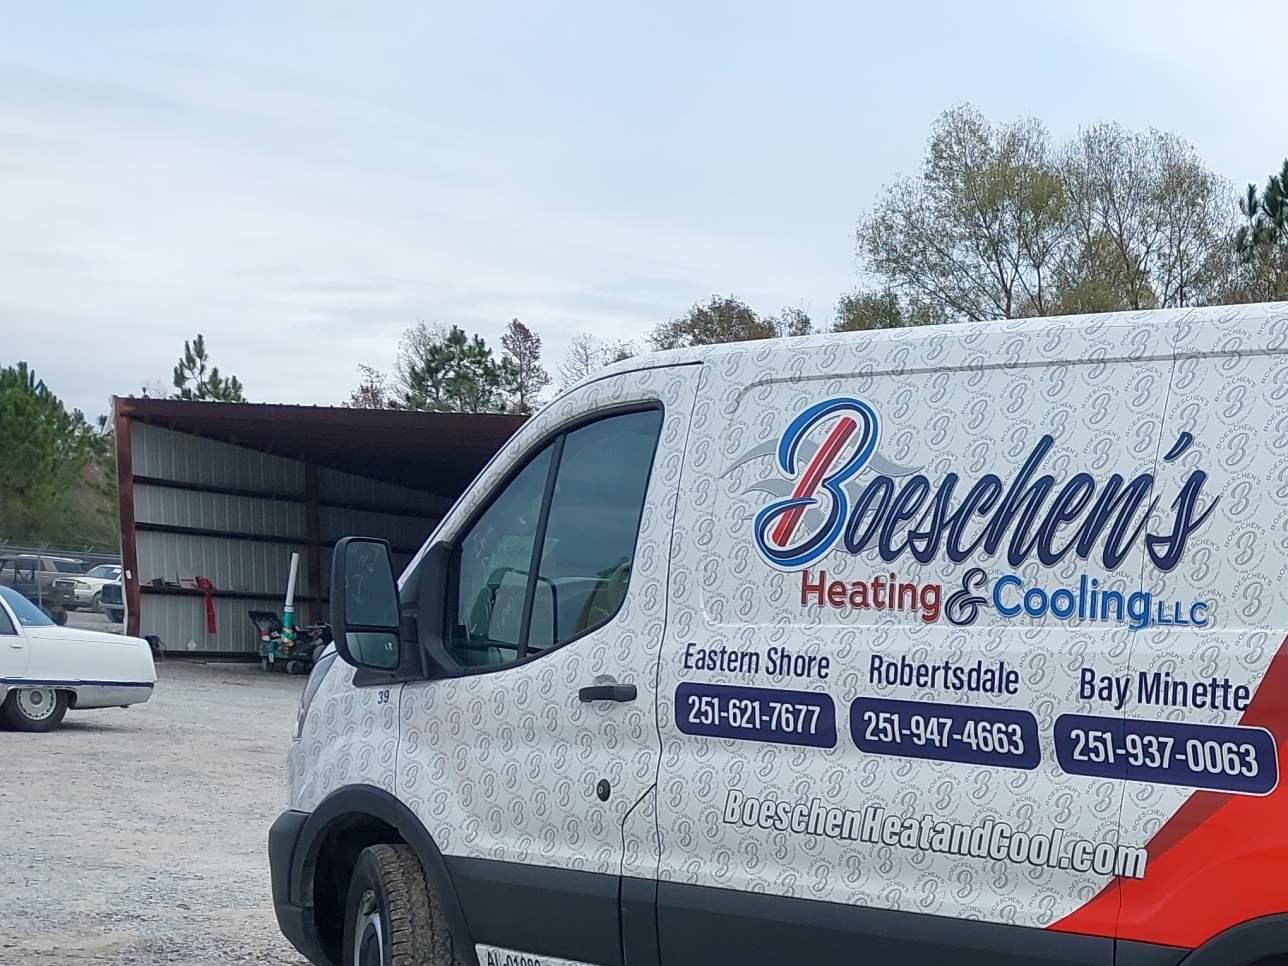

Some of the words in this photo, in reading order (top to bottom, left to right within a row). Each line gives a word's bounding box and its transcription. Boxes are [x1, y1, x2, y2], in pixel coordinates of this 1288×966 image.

[754, 396, 1221, 571] Boeschen's
[800, 568, 942, 625] Heating
[943, 566, 988, 627] &
[683, 643, 760, 674] Eastern
[765, 646, 830, 680] Shore
[868, 654, 1020, 695] Robertsdale
[377, 690, 390, 704] 39
[1080, 668, 1130, 711] Bay
[1138, 671, 1250, 712] Minette
[687, 695, 821, 735] 251-621-7677
[863, 710, 1024, 755] 251-947-4663
[1070, 728, 1258, 778] 251-937-0063
[723, 789, 1148, 880] BoeschenHeatandCool.com
